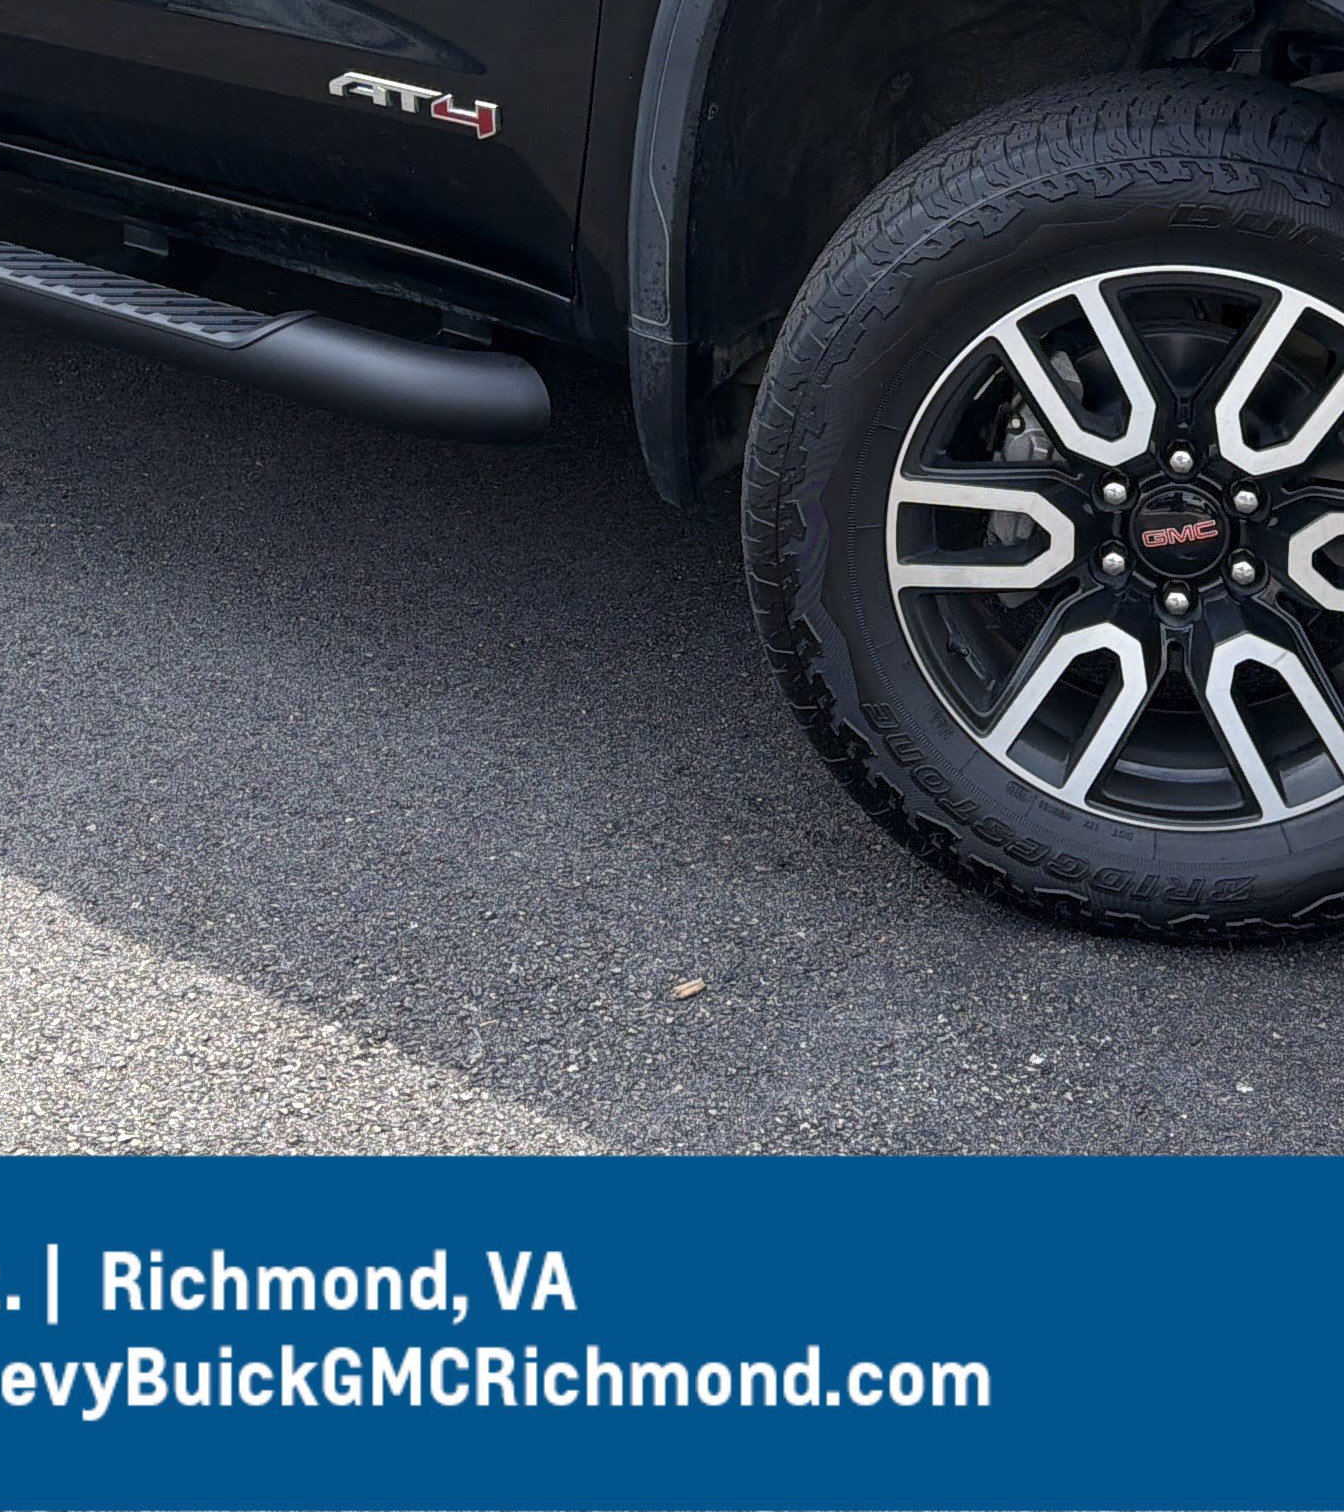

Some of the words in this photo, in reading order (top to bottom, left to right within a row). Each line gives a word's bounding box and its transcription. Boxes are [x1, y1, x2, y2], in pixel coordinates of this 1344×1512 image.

[328, 71, 500, 139] AT4
[1142, 519, 1219, 548] GMC
[860, 702, 1258, 905] BRIDGESTONE
